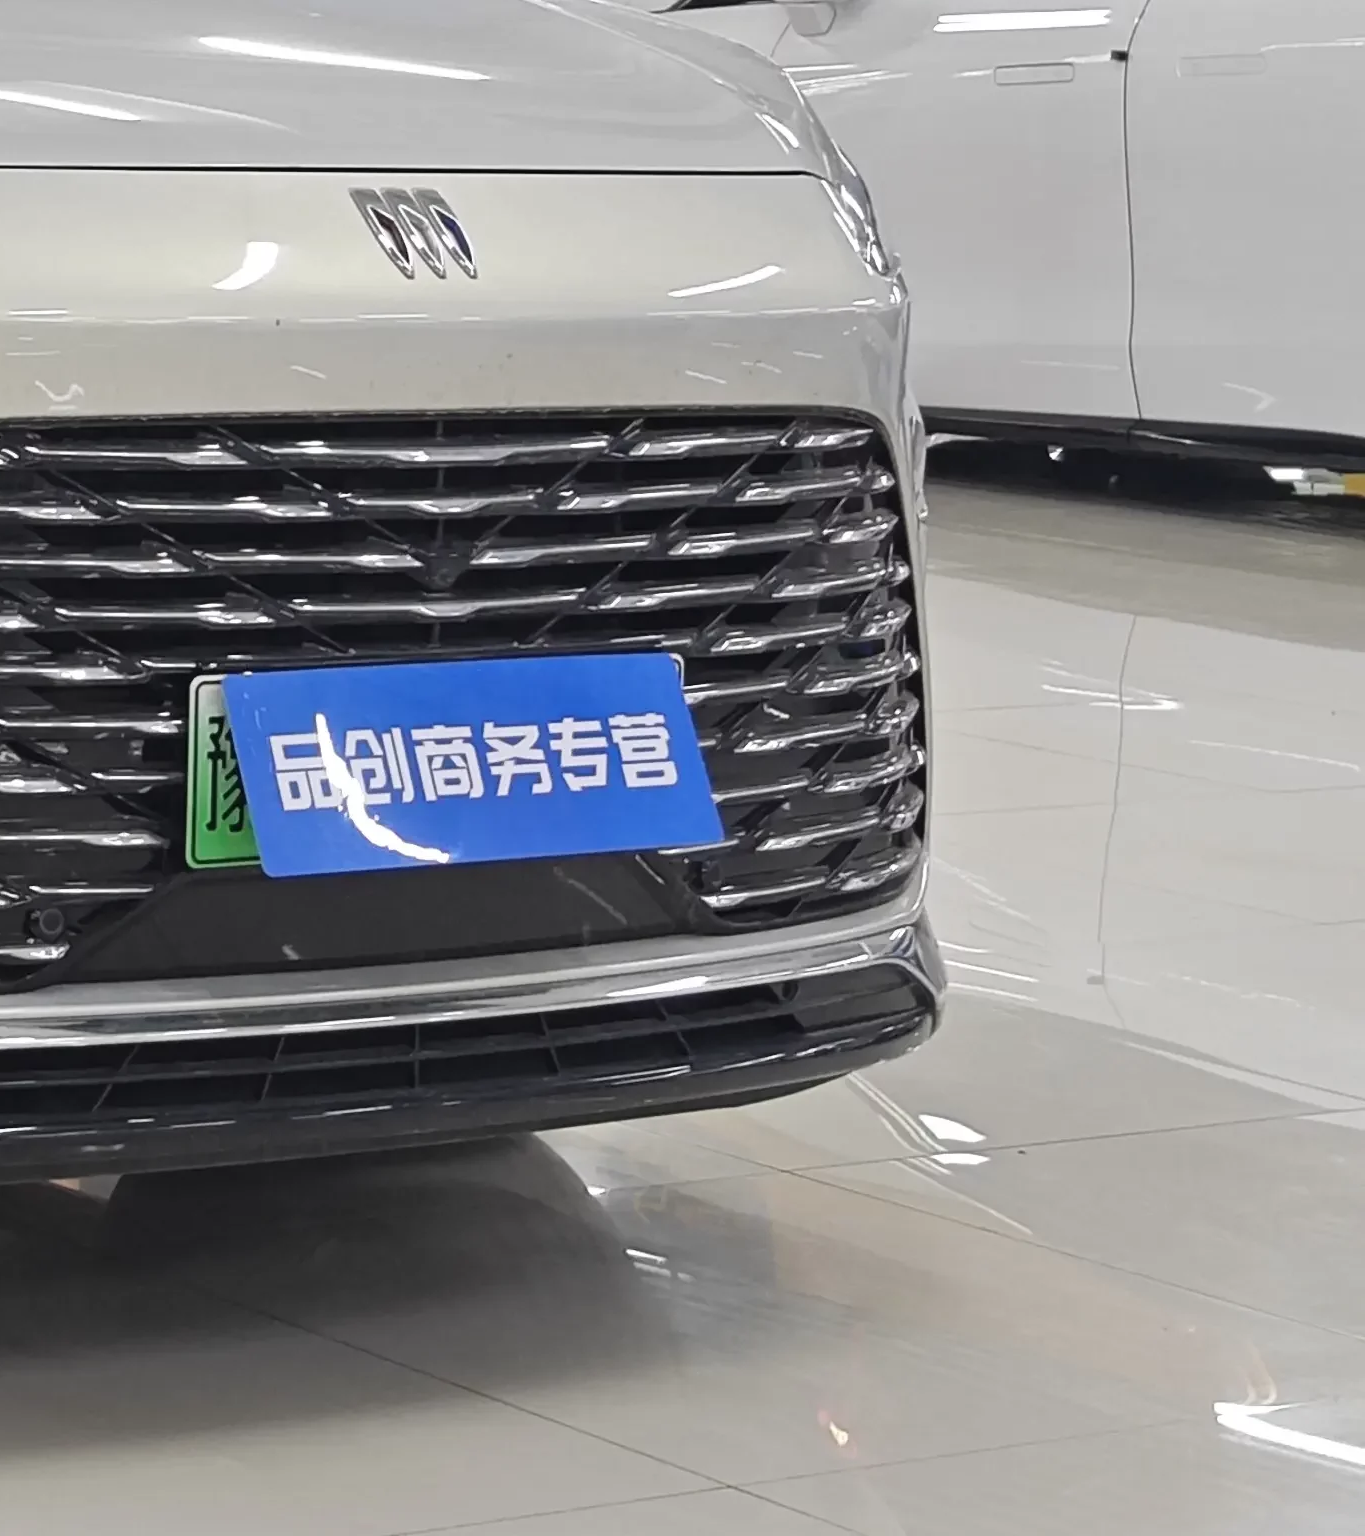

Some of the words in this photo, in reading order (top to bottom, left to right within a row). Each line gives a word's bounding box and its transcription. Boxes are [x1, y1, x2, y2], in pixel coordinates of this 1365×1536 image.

[268, 713, 679, 813] 品创商务专营
